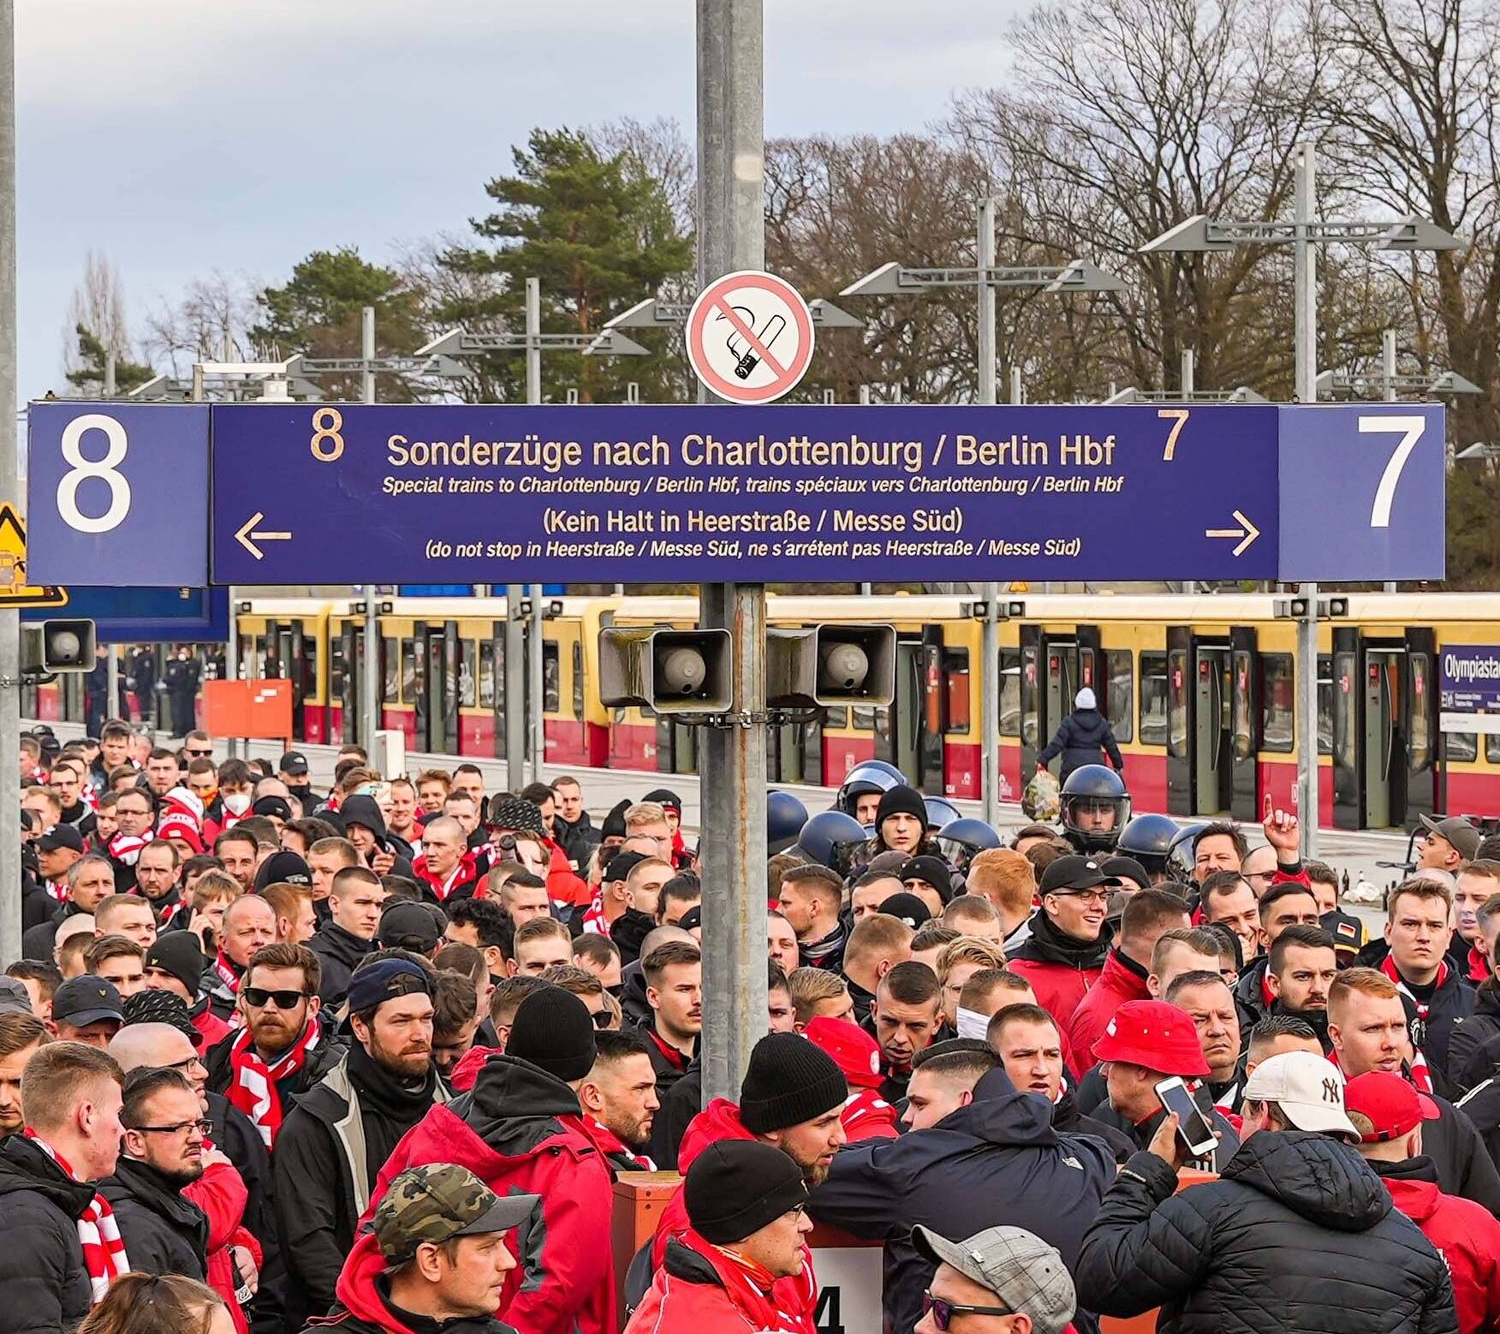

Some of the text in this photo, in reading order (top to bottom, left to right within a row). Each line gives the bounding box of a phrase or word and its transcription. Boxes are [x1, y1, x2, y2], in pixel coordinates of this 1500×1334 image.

[310, 407, 344, 461] 8
[387, 434, 1116, 473] Sonderzüge nach Charlottenburg / Berlin Hbf
[1157, 409, 1190, 461] 7
[56, 414, 131, 533] 8
[382, 476, 444, 497] Special
[448, 476, 494, 493] trains
[498, 477, 515, 493] to
[518, 476, 641, 497] Charlottenburg
[655, 476, 704, 493] Berlin
[707, 476, 741, 495] Hbf,
[746, 476, 792, 493] trains
[794, 475, 868, 496] spéciaux
[871, 479, 905, 493] vers
[909, 475, 1029, 496] Charlottenburg
[1043, 475, 1091, 493] Berlin
[1093, 476, 1125, 493] Hbf
[1358, 415, 1426, 527] 7
[543, 506, 963, 535] (Kein Halt in Heerstraße / Messe Süd)
[425, 539, 452, 559] (do
[455, 541, 484, 558] not
[485, 541, 522, 561] stop
[526, 540, 542, 557] in
[545, 540, 635, 557] Heerstraße
[649, 540, 703, 557] Messe
[706, 539, 743, 559] Süd,
[747, 543, 769, 557] ne
[851, 543, 882, 560] pas
[885, 539, 974, 556] Heerstraße
[988, 539, 1041, 556] Messe
[1044, 537, 1081, 557] Süd)
